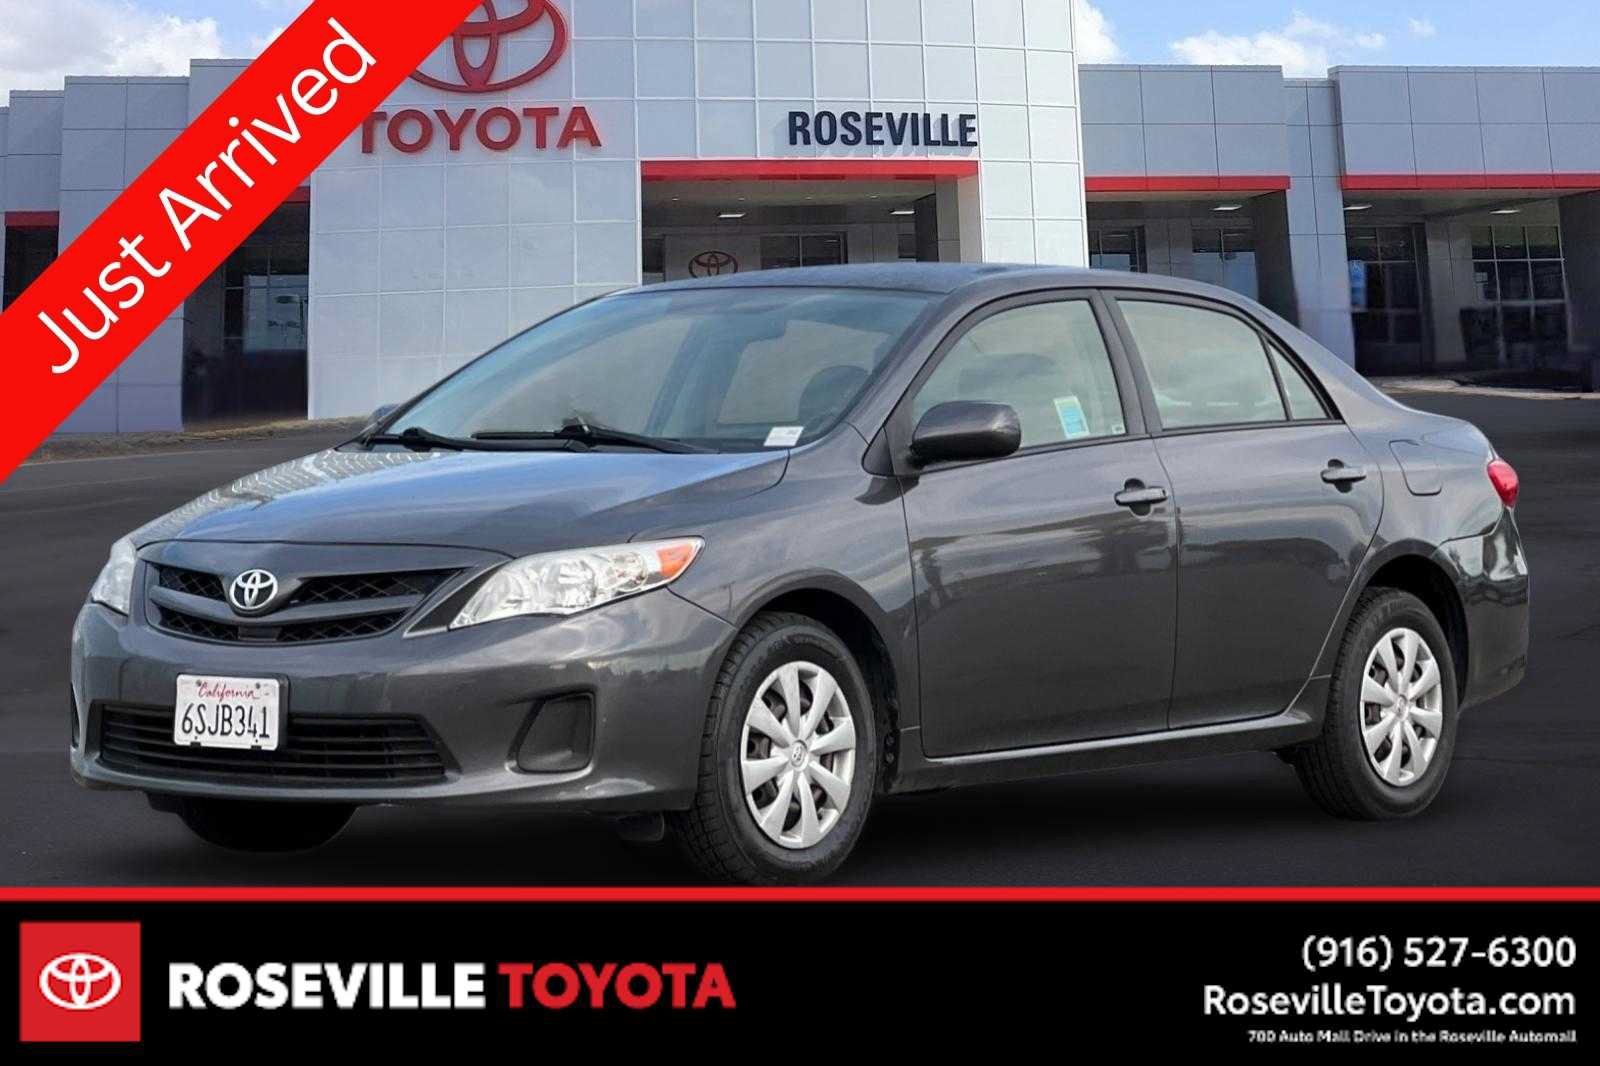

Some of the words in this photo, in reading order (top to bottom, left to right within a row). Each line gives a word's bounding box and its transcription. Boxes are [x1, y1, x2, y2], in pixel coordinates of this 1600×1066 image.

[360, 106, 602, 154] TOYOTA
[788, 110, 978, 148] ROSEVILLE
[198, 681, 260, 702] California
[181, 702, 271, 739] 6SJB341
